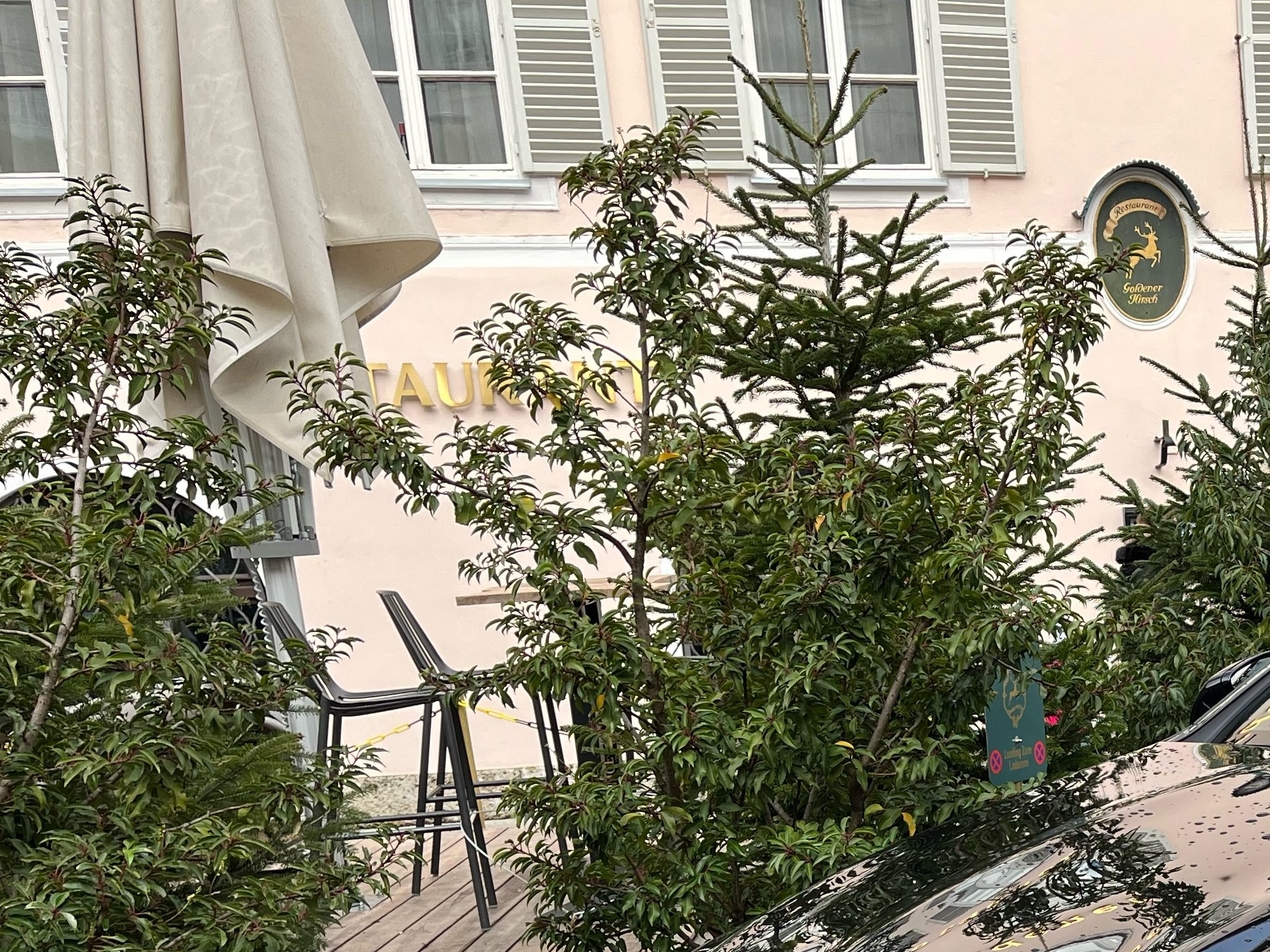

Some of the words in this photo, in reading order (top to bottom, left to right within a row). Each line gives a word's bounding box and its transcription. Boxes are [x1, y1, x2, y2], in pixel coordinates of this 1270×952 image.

[1113, 200, 1158, 219] Restaurant
[1122, 282, 1164, 294] Goldener
[1127, 293, 1159, 305] Hirsch
